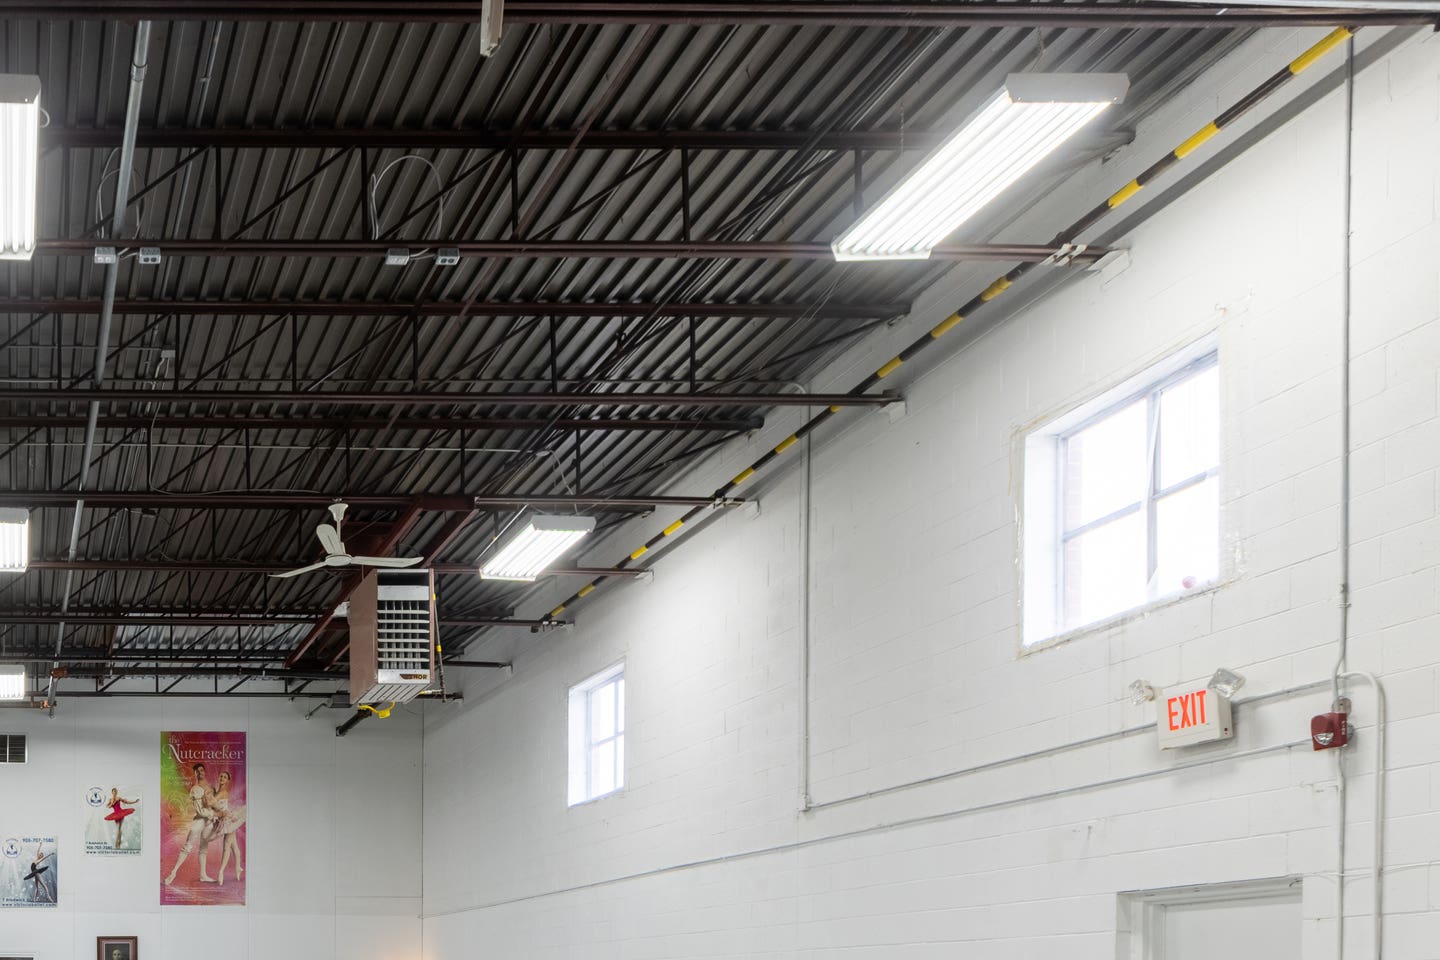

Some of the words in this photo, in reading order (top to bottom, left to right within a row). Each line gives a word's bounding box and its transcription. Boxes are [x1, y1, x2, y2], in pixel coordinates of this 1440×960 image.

[1167, 689, 1207, 731] EXIT
[168, 735, 181, 744] the
[162, 743, 245, 763] Nutcracker
